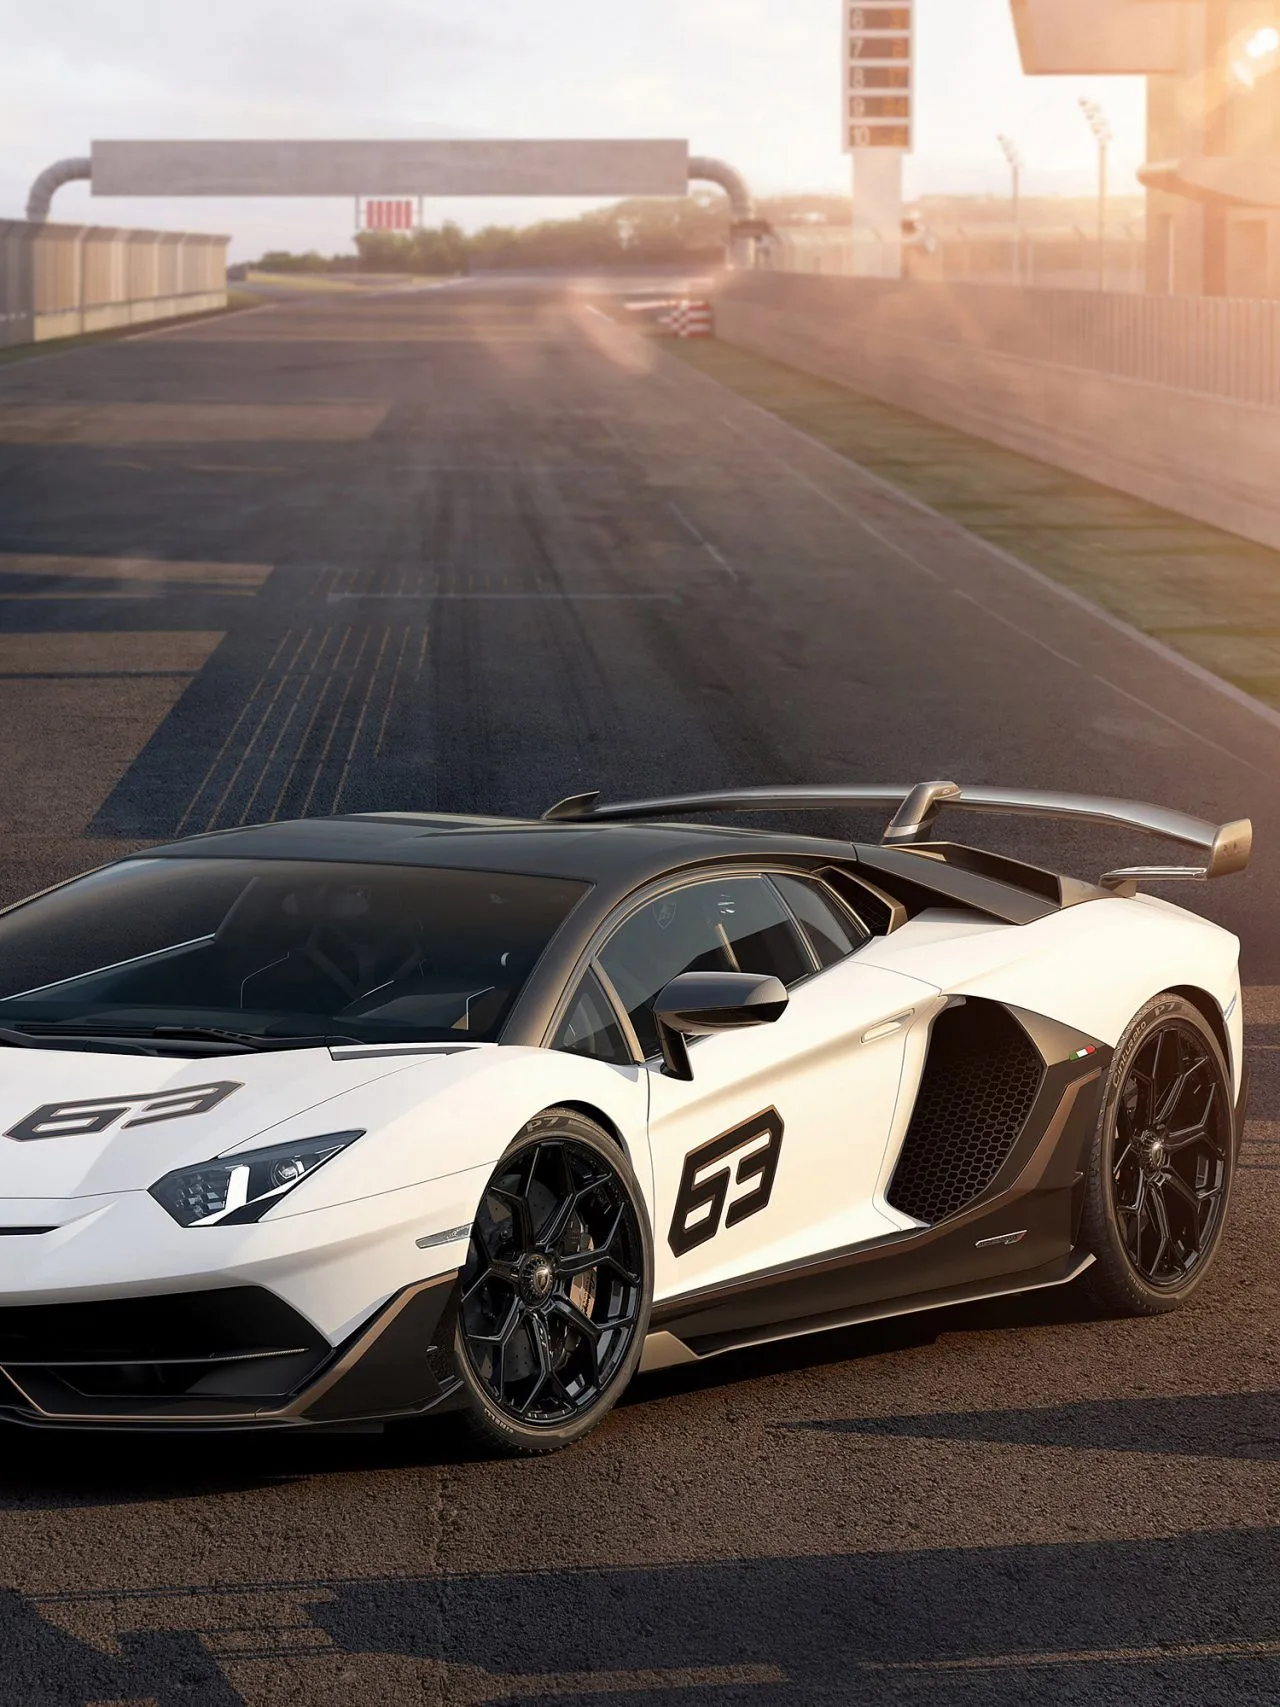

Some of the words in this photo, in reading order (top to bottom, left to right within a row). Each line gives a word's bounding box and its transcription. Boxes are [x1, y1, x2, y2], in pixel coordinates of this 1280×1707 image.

[1112, 1021, 1147, 1088] Cinturato
[1154, 1002, 1176, 1016] P7
[2, 1080, 245, 1142] 63
[526, 1117, 559, 1132] P7
[667, 1104, 785, 1258] 63
